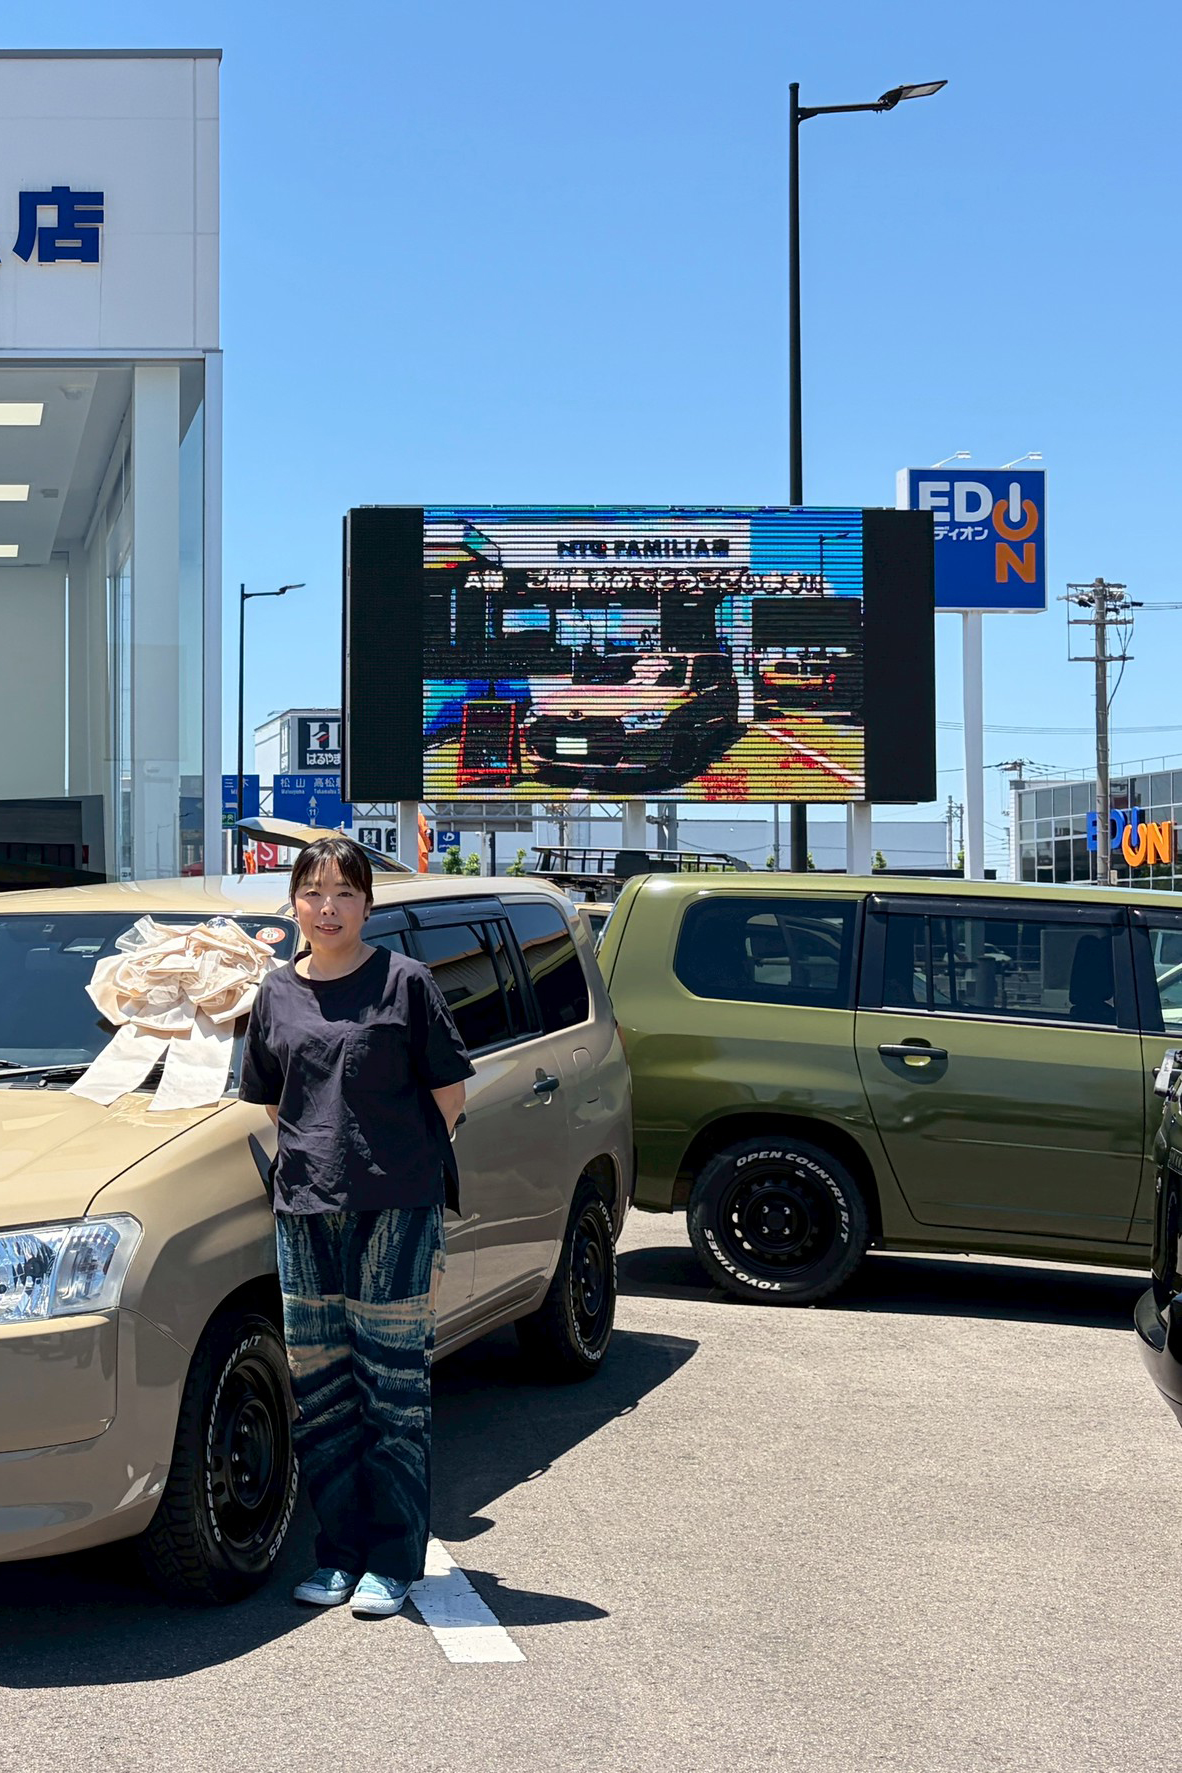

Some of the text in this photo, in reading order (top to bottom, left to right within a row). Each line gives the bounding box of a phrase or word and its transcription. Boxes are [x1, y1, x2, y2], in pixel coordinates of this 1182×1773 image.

[934, 526, 988, 541] ディオン
[306, 753, 341, 765] はるやま
[281, 777, 306, 788] 松山
[736, 1151, 783, 1167] OPEN
[785, 1153, 847, 1208] COUNTRY
[704, 1228, 781, 1291] TOYO TIRES
